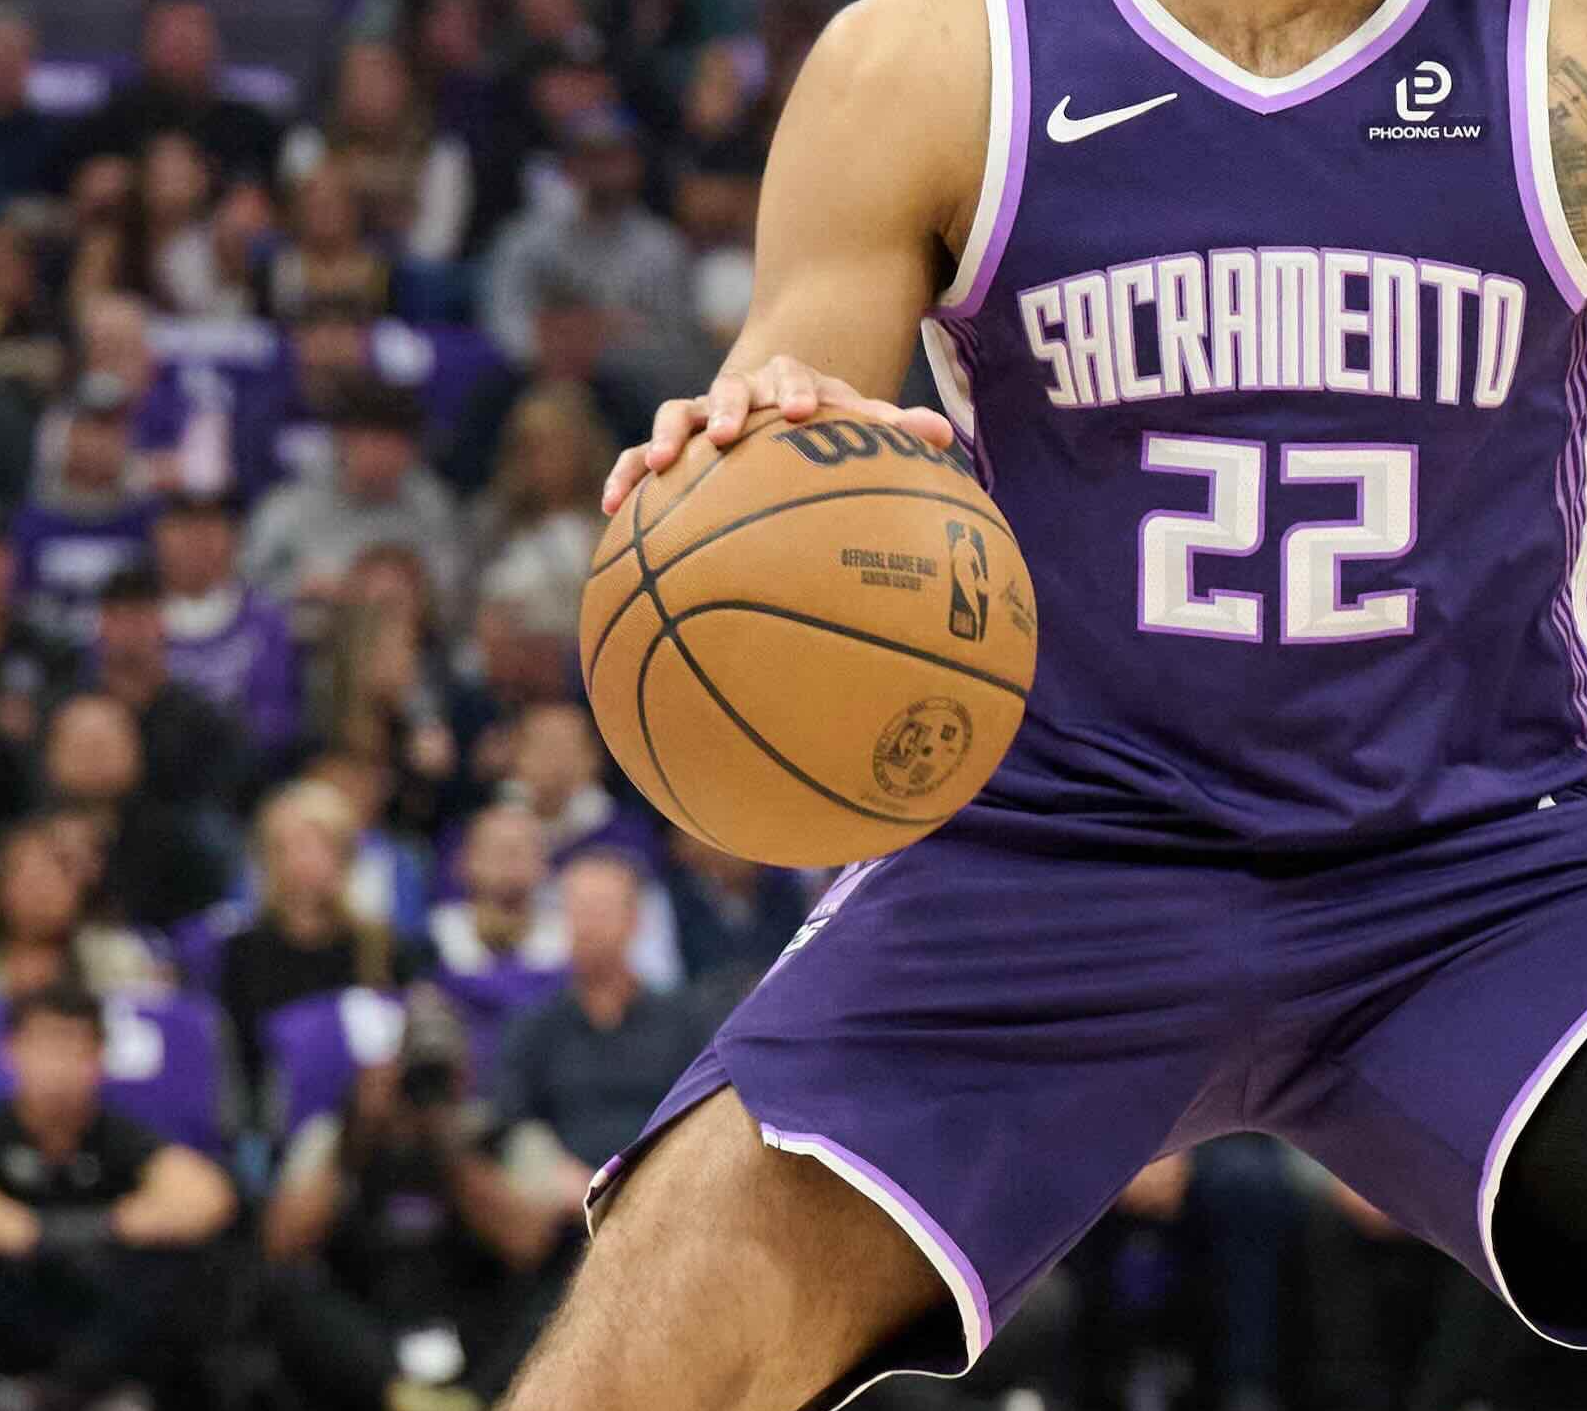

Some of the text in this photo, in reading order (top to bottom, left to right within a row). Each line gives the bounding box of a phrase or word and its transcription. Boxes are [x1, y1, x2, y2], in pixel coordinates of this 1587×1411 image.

[1369, 125, 1481, 140] PHOONG LAW
[1017, 245, 1525, 409] SACRAMENTO
[840, 548, 885, 569] OFFICIAL
[1137, 431, 1419, 644] 22
